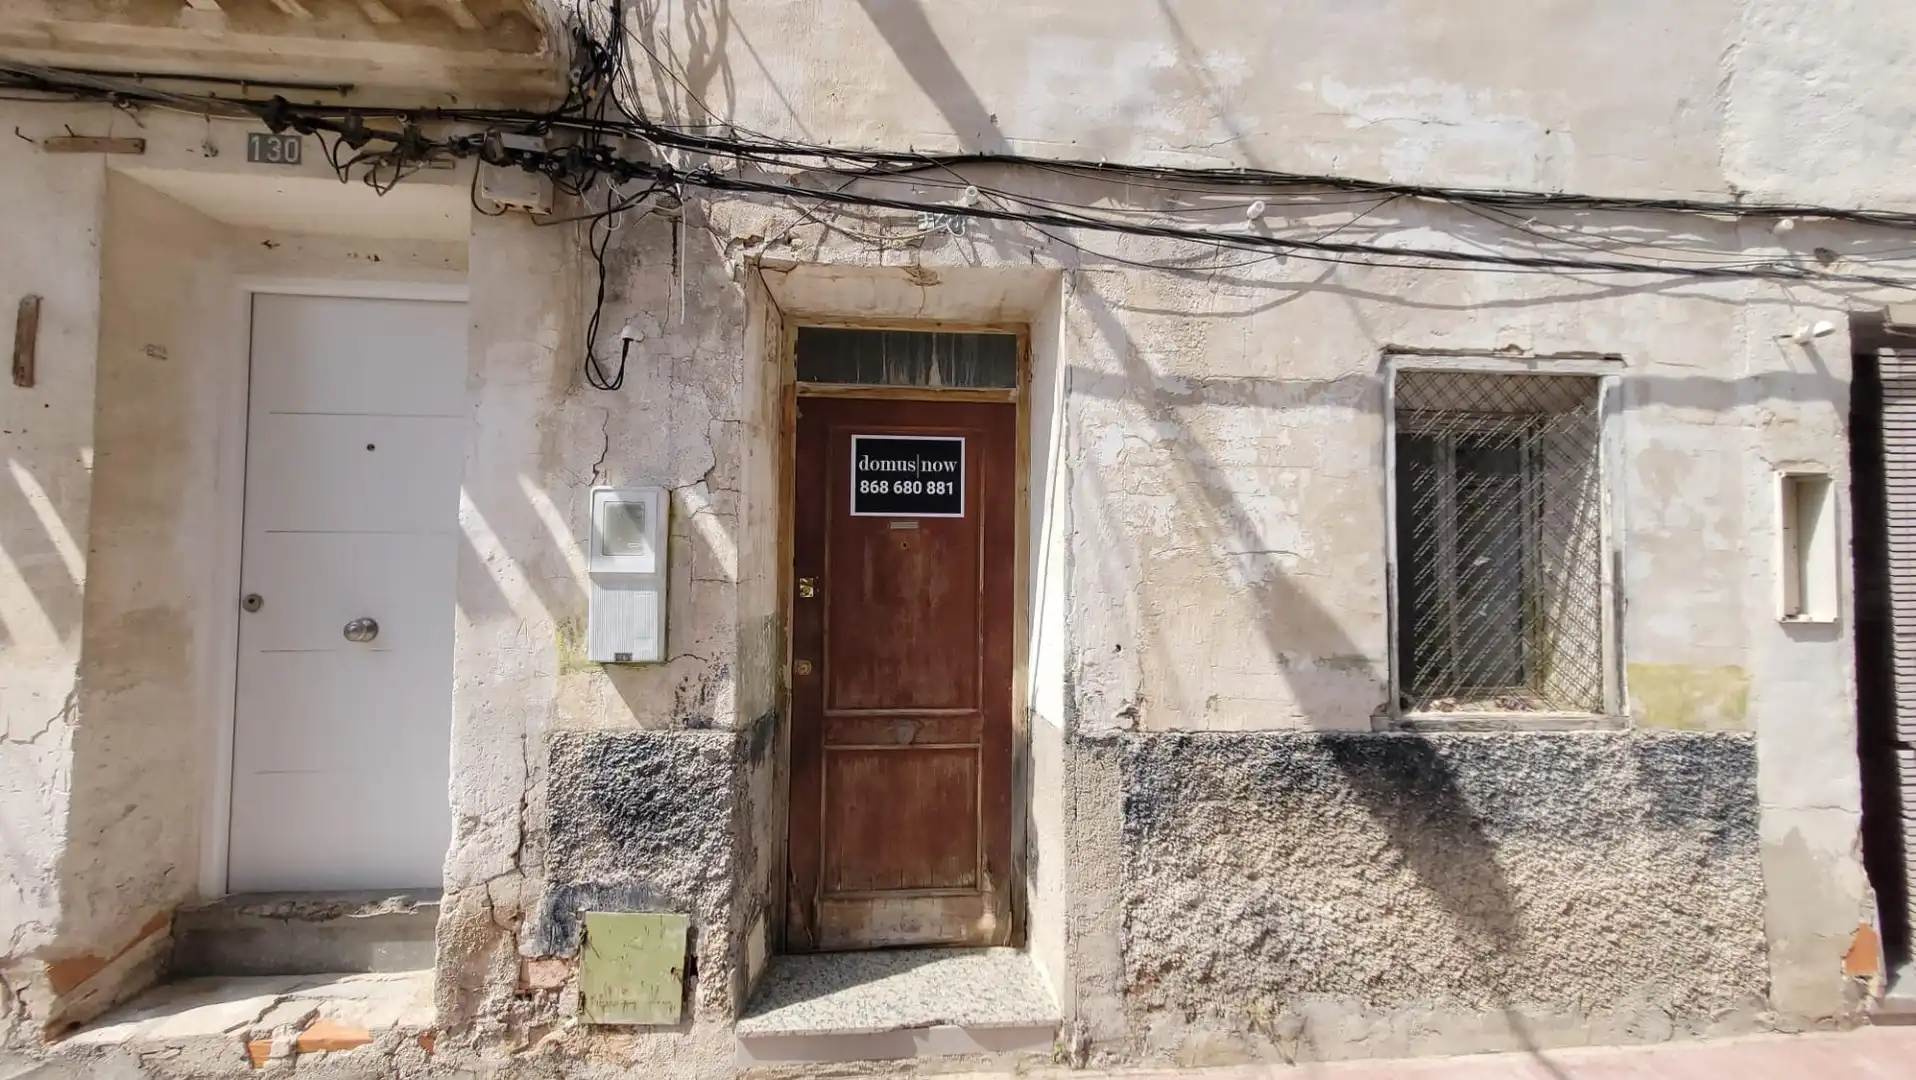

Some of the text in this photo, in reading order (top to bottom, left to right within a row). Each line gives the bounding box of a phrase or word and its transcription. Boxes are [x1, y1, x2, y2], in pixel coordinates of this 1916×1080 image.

[251, 135, 299, 163] 130
[860, 480, 953, 495] 868 680 881
